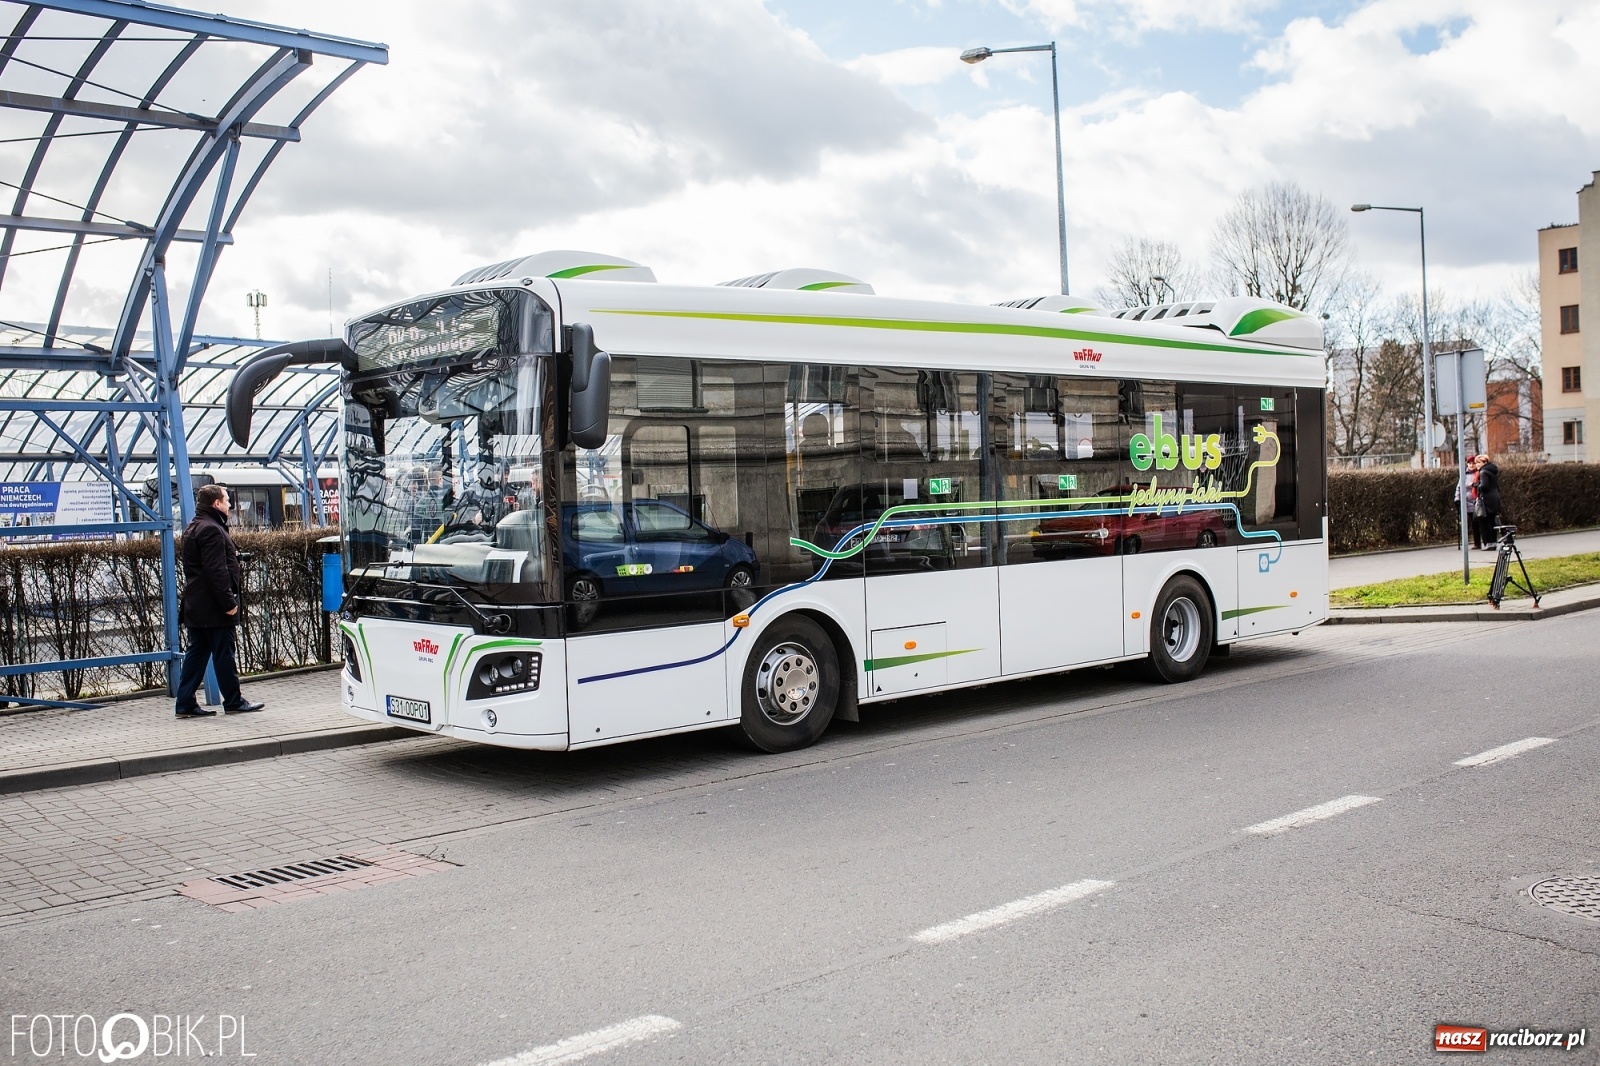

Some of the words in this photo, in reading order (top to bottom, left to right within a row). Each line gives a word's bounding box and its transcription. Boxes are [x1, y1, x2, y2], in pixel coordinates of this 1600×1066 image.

[1129, 413, 1222, 471] ebus
[2, 486, 31, 494] PRACA
[0, 494, 42, 502] NIEMCZECH
[1128, 475, 1187, 517] jedyny
[1191, 474, 1223, 503] taki
[313, 506, 339, 514] CEKA
